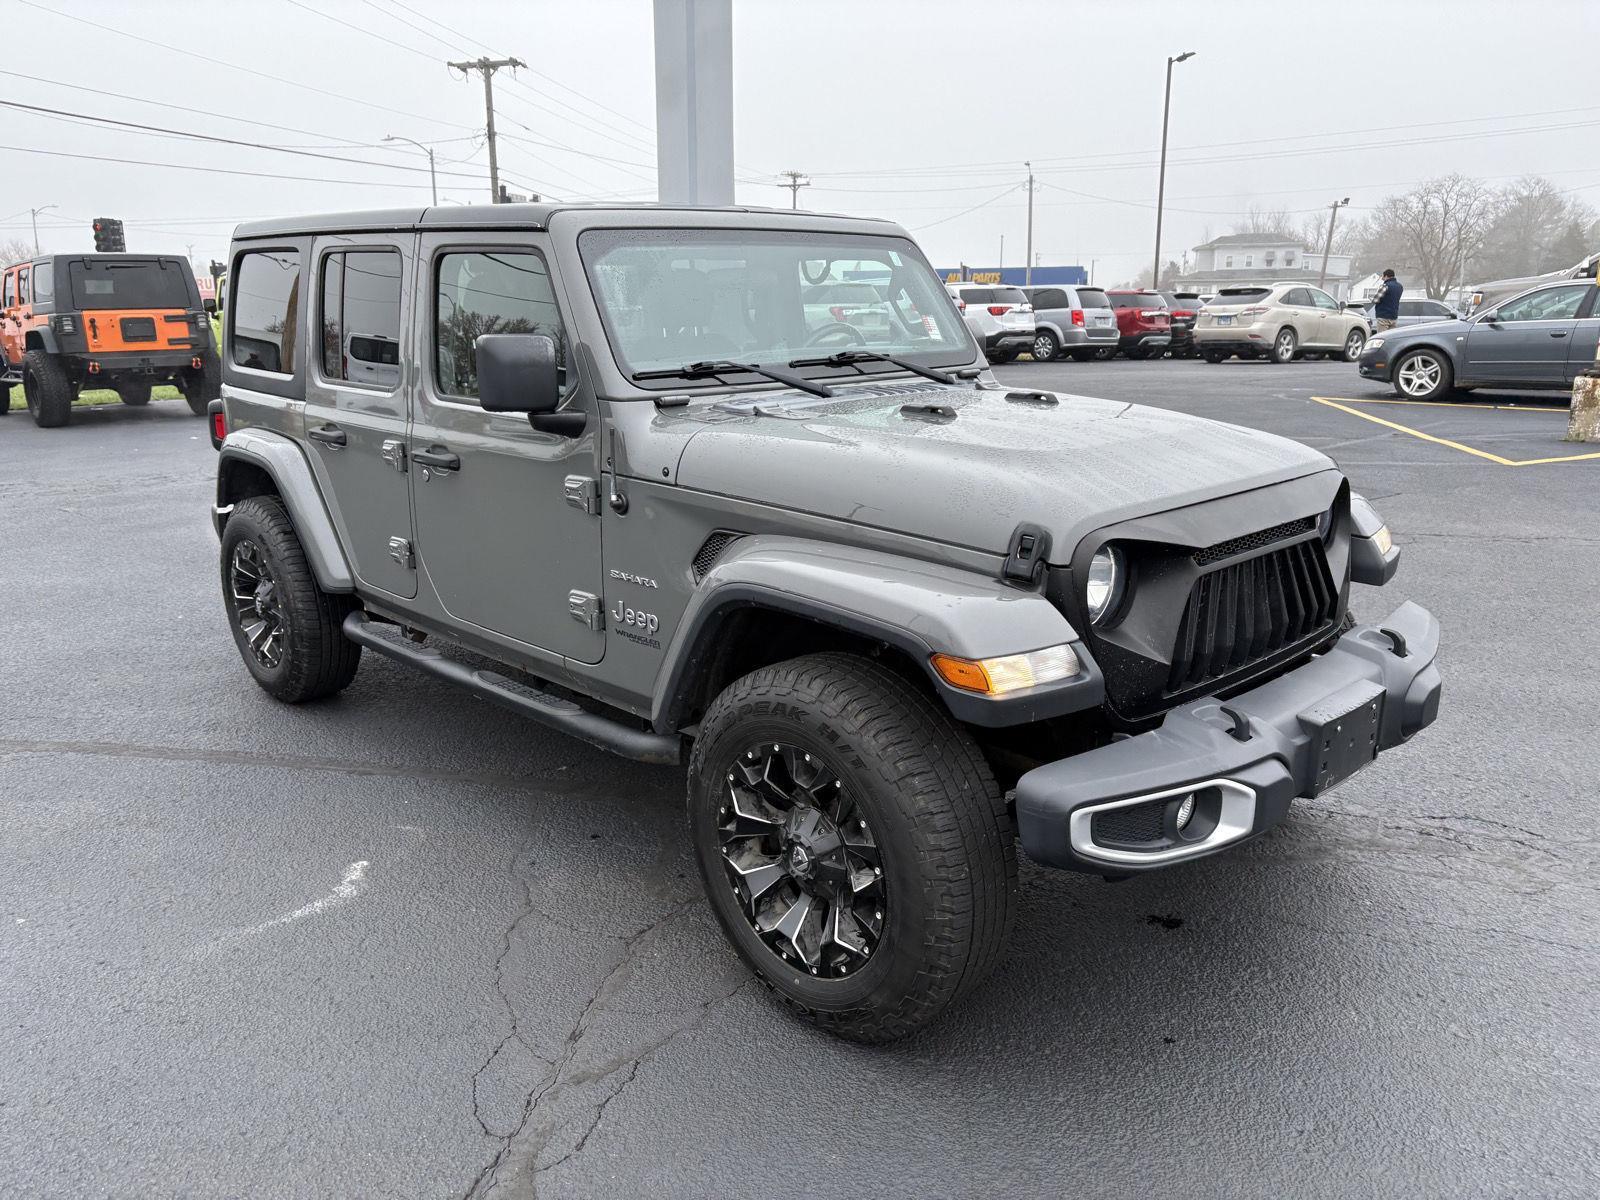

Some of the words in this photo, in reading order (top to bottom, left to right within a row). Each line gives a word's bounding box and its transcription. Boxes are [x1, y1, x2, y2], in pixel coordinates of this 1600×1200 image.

[972, 272, 1001, 284] PARTS
[610, 569, 658, 589] SAHARA
[611, 600, 660, 636] Jeep
